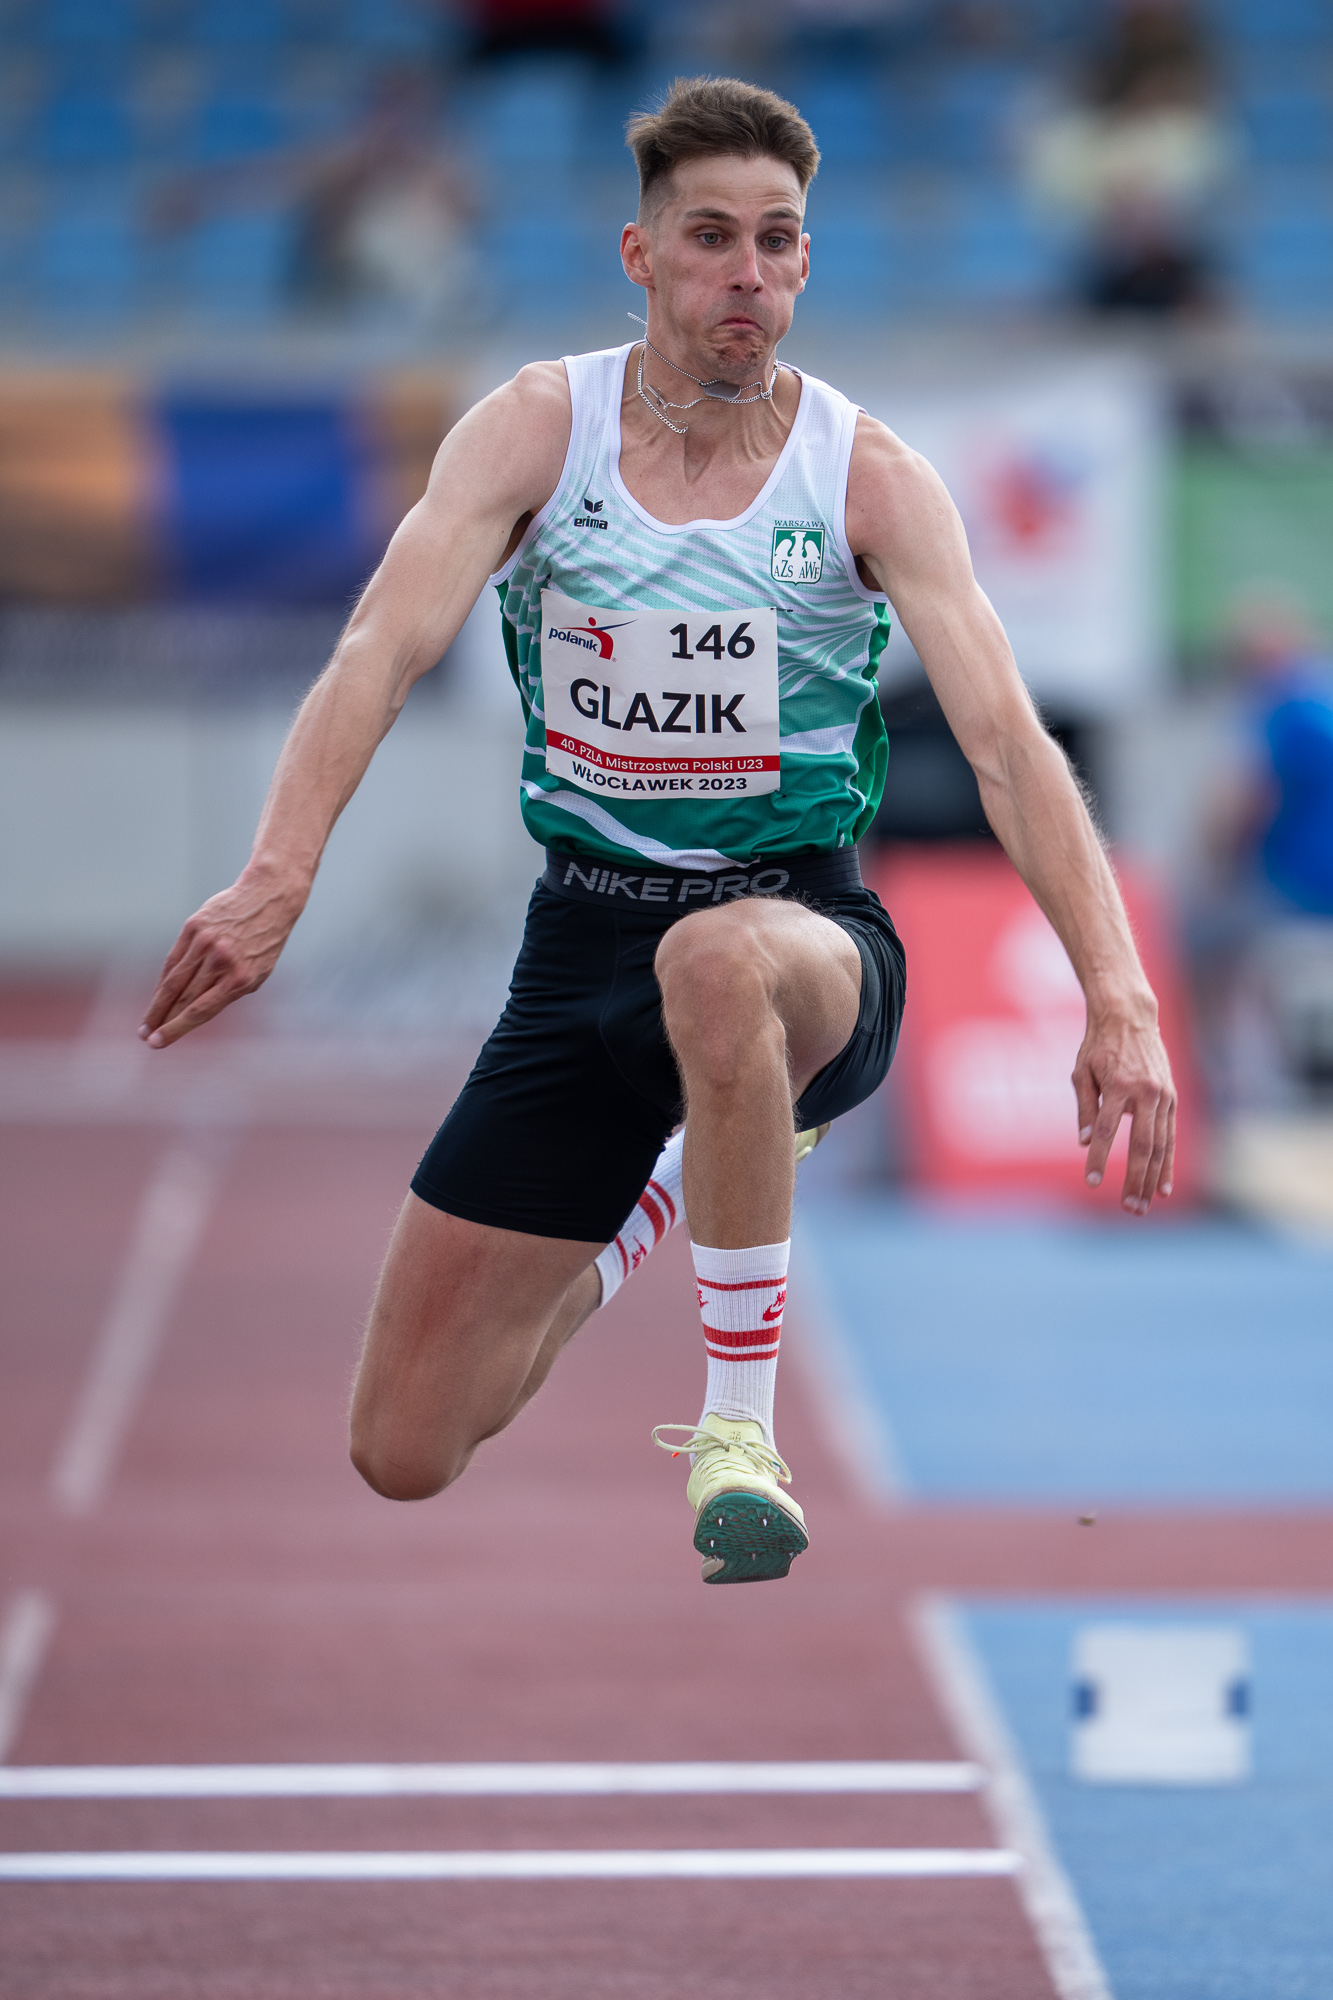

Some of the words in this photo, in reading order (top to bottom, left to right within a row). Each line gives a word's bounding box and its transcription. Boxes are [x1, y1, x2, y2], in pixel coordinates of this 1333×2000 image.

[574, 515, 608, 530] erima
[774, 520, 825, 528] WARSZAWA
[774, 560, 793, 577] AZS
[799, 561, 820, 579] AWF
[548, 627, 598, 652] polanik
[669, 622, 755, 660] 146
[570, 678, 747, 734] GLAZIK
[560, 738, 578, 753] 40.
[580, 745, 602, 765] PZLA
[606, 757, 689, 771] Mistrzostwa
[693, 760, 733, 771] Polski
[737, 759, 764, 770] U23
[572, 760, 694, 791] WŁOCŁAWEK
[698, 777, 748, 791] 2023
[563, 861, 674, 902] NIKE
[677, 868, 790, 903] PRO
